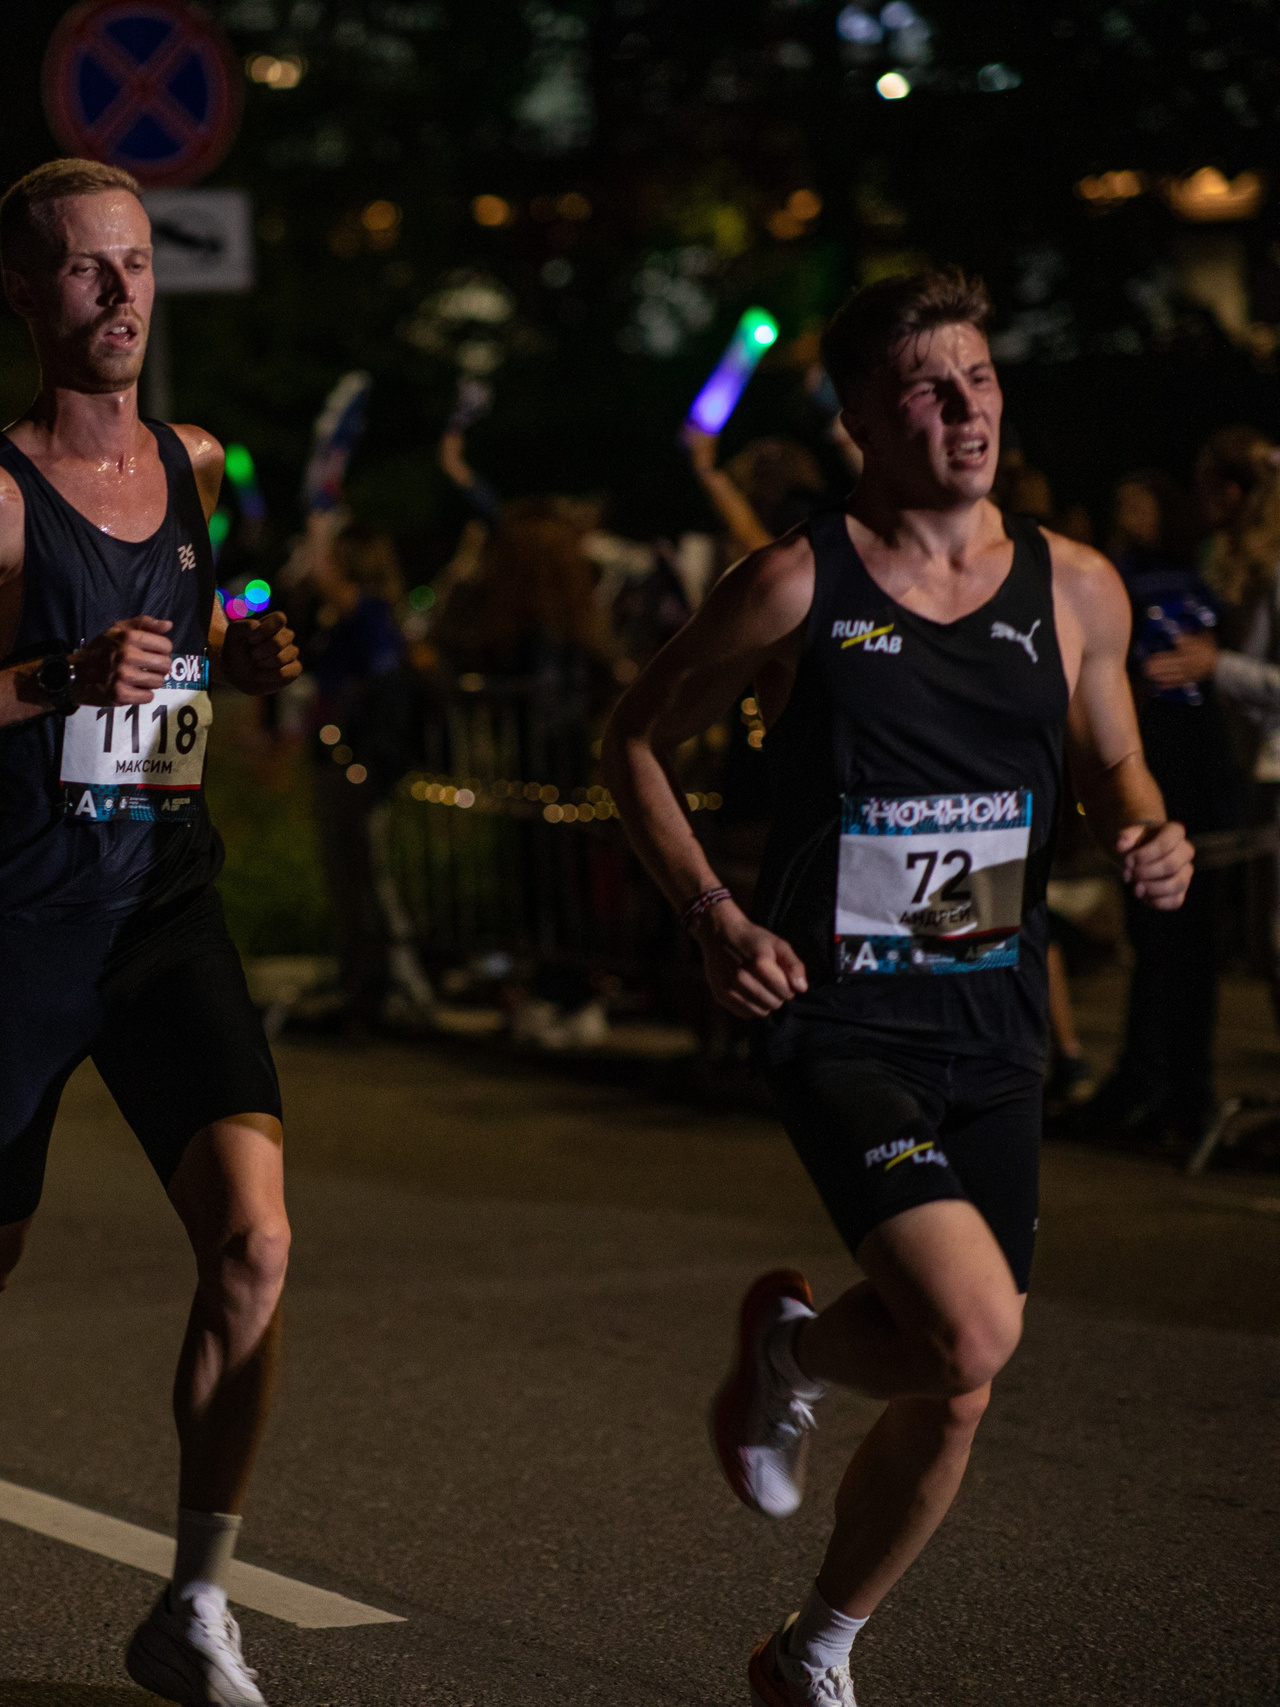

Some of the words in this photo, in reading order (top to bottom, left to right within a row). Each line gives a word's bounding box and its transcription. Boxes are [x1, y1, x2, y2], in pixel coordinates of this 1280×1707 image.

[830, 618, 876, 639] RUN
[862, 633, 904, 655] LAB
[96, 704, 198, 755] 1118
[115, 759, 173, 774] МАКСИМ
[862, 791, 1020, 828] НОЧНОЙ
[906, 849, 972, 905] 72
[864, 1135, 916, 1169] RUN
